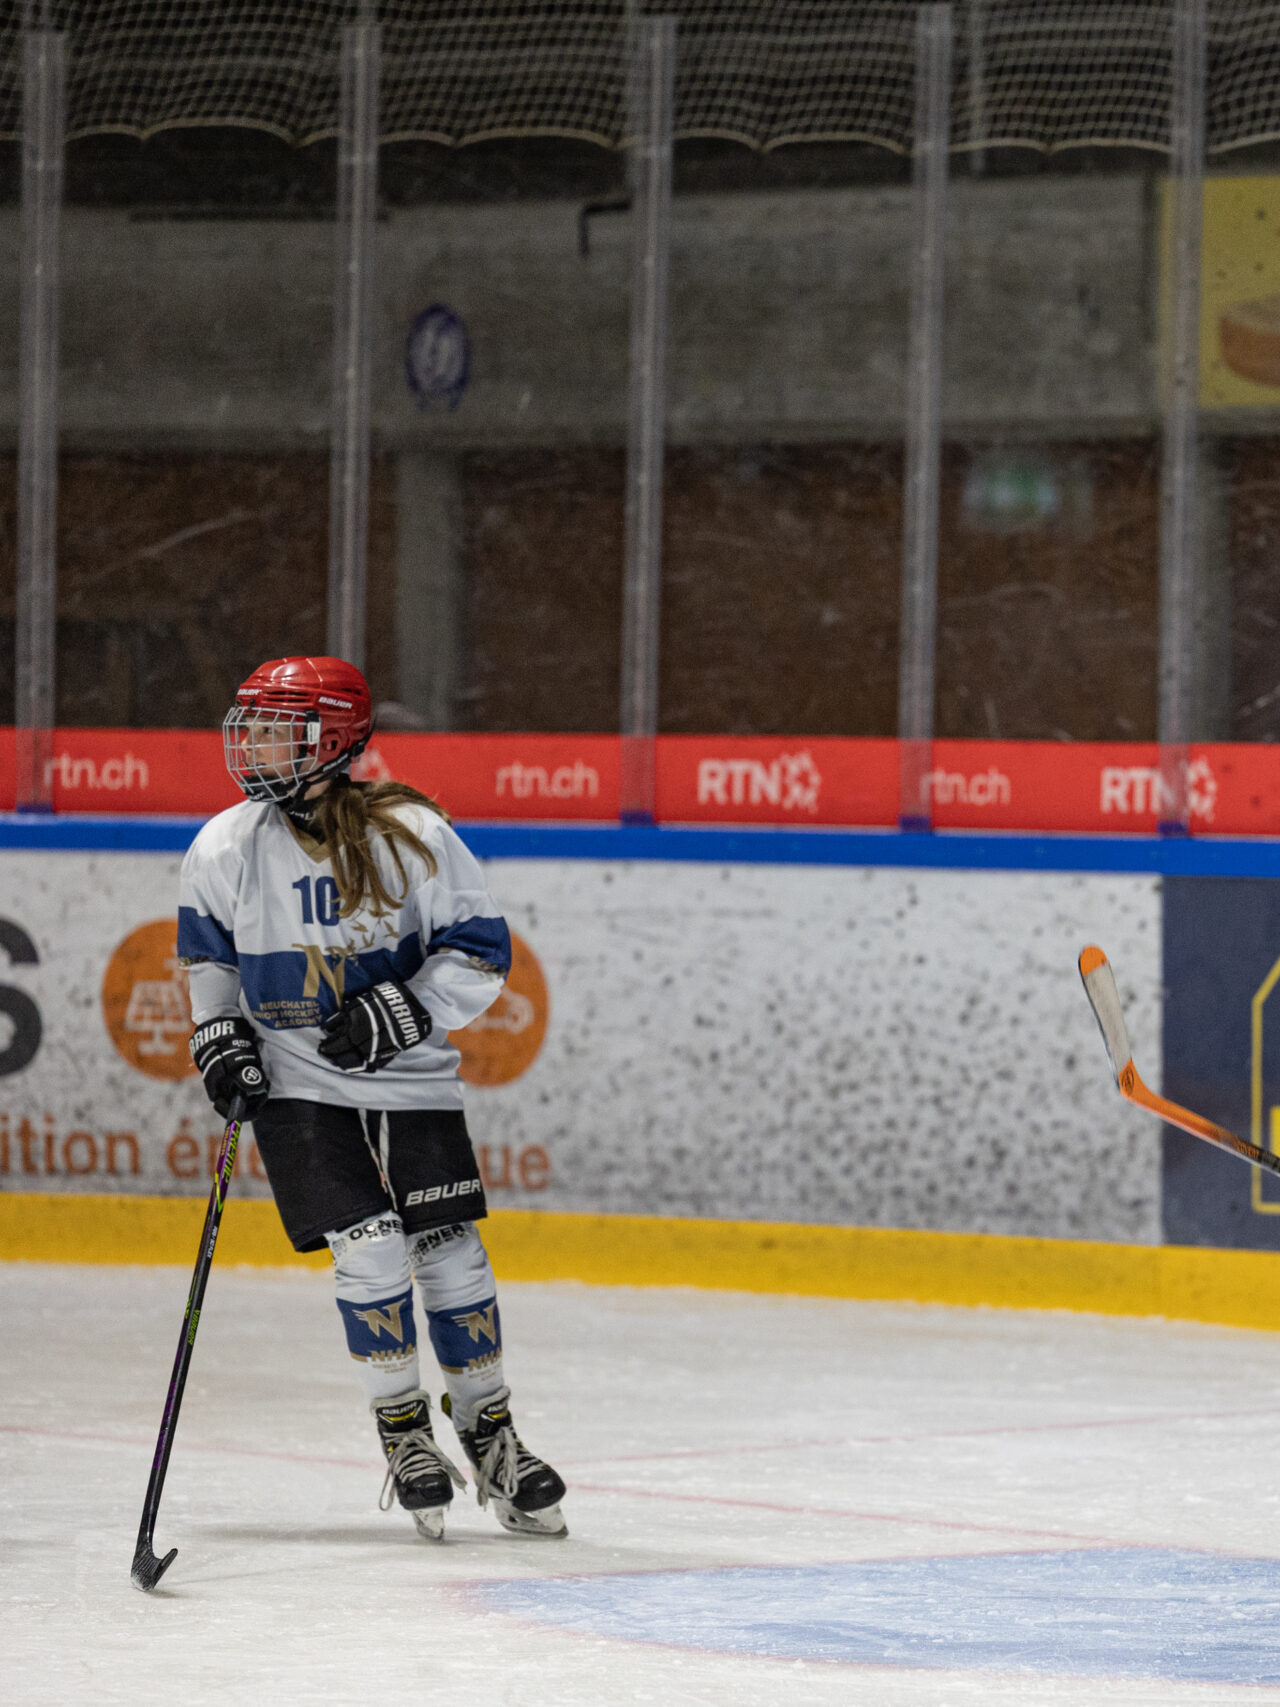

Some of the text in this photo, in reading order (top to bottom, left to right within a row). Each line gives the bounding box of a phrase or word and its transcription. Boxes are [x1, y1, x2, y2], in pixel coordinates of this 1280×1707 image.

[44, 752, 149, 790] rtn.ch
[495, 762, 599, 799] rtn.ch
[698, 758, 781, 806] RTN
[920, 764, 1010, 805] rtn.ch
[292, 875, 341, 926] 10
[371, 1344, 414, 1362] NHA
